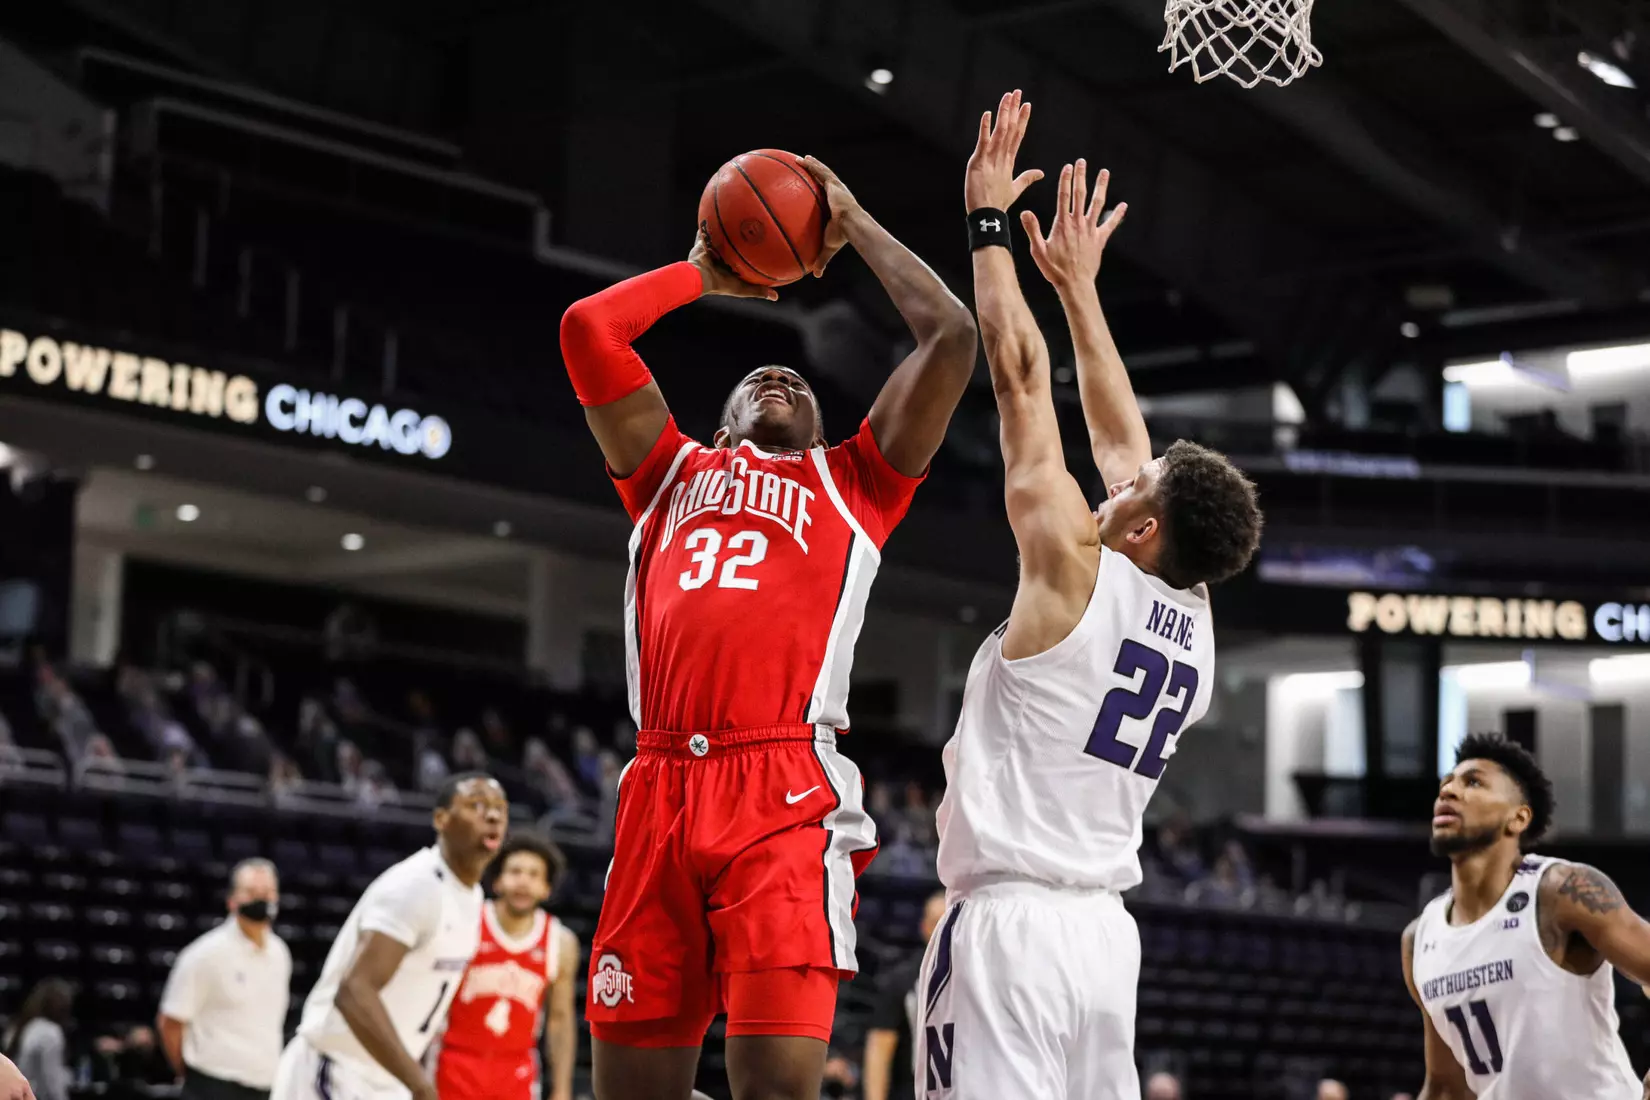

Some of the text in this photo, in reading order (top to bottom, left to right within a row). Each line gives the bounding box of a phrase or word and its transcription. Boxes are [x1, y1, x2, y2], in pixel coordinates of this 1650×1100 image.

[0, 329, 452, 459] POWERING CHICAGO
[721, 457, 816, 555] STATE
[678, 528, 769, 592] 32
[1347, 592, 1650, 642] POWERING CH
[1083, 638, 1199, 780] 22
[1422, 959, 1514, 1001] NORTHWESTERN
[926, 1022, 954, 1091] N
[1444, 999, 1503, 1075] 11
